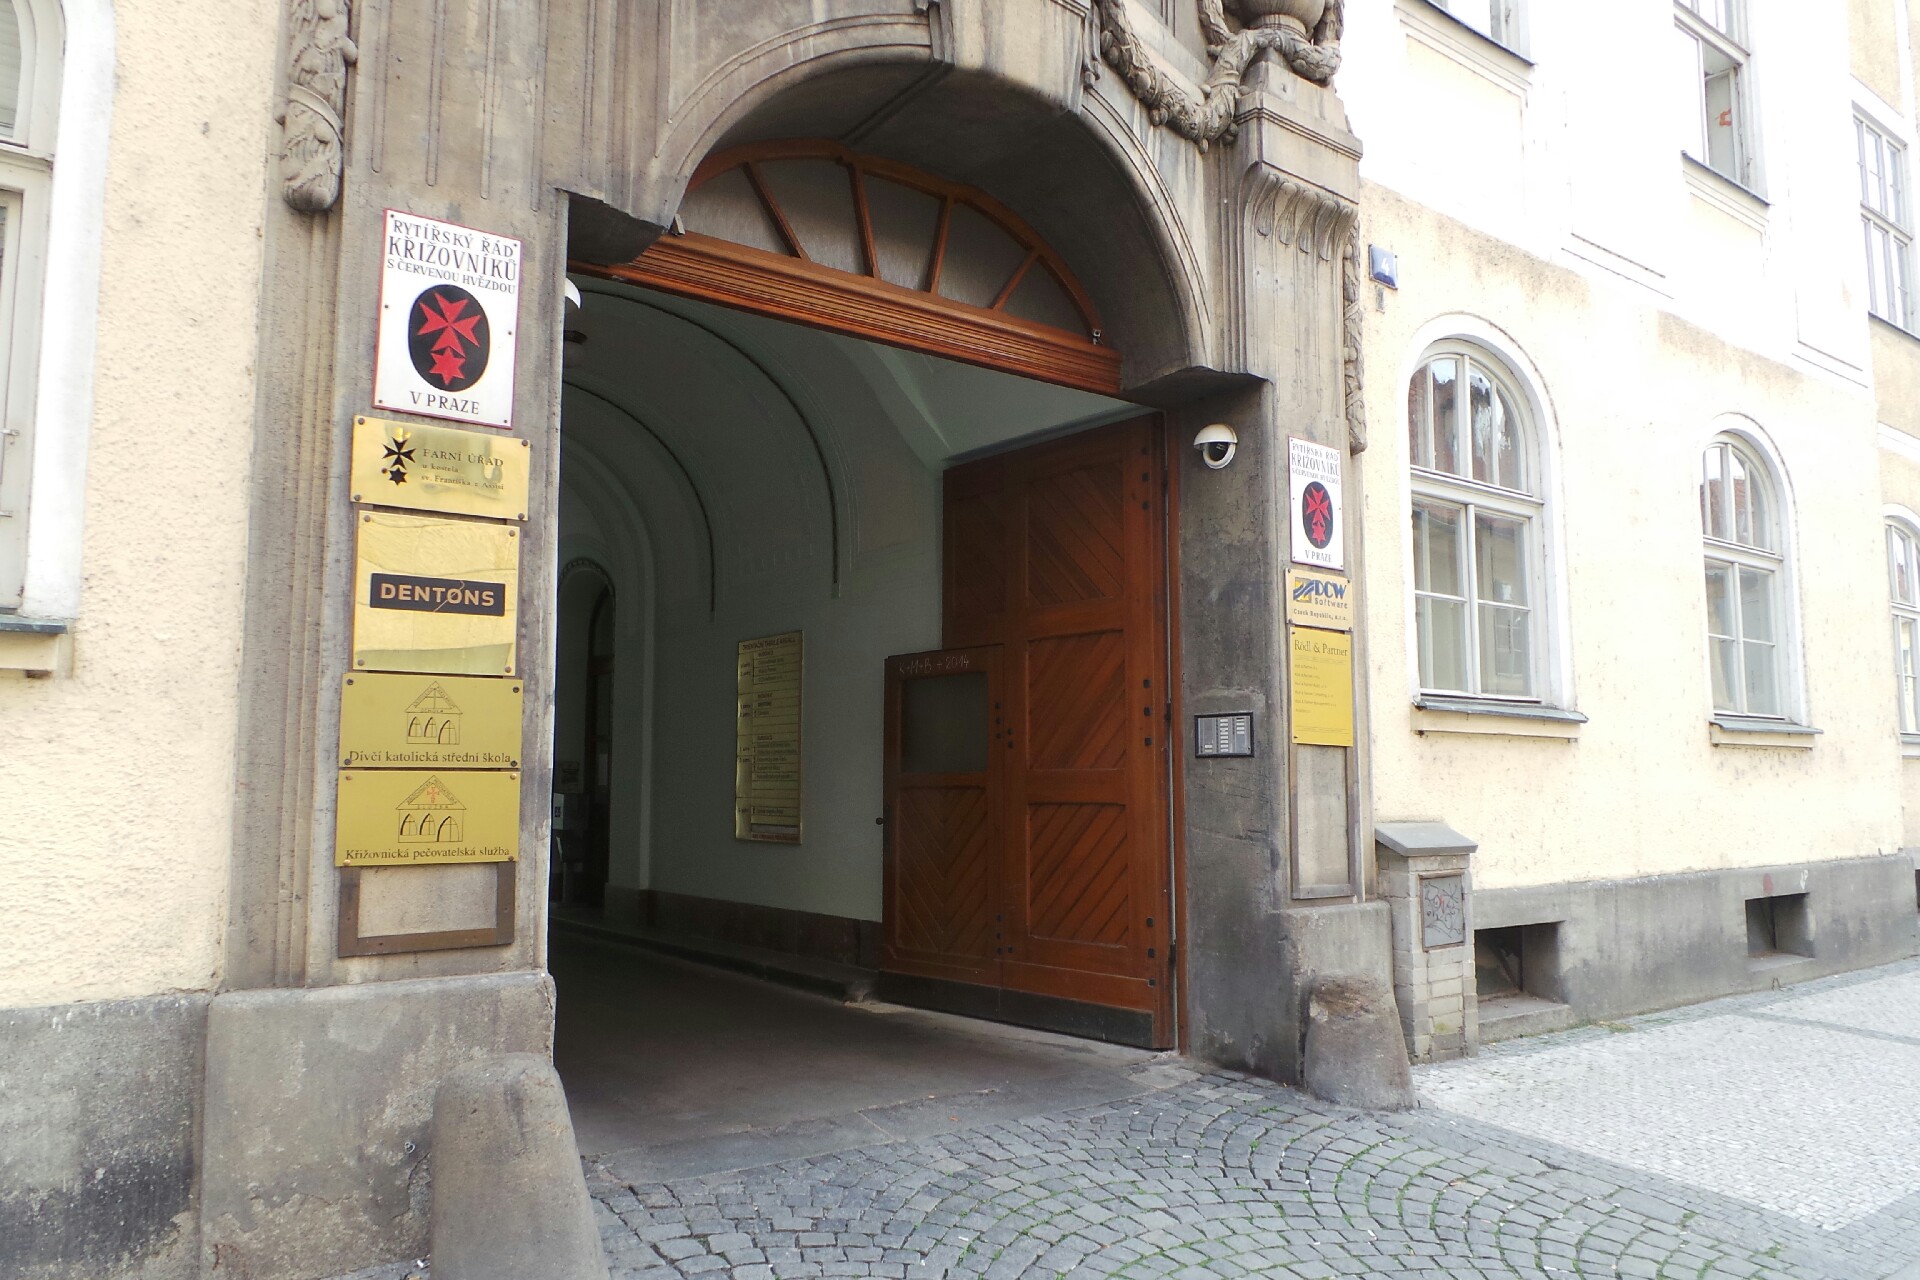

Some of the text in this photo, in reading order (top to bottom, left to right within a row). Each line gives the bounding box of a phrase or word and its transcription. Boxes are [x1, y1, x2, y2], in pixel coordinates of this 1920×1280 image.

[393, 219, 513, 257] RYTÍŘSKÝ ŘÁD
[389, 236, 517, 281] KŘIŽOVNÍKŮ
[1381, 258, 1390, 276] 4
[387, 258, 516, 294] S ČERVENOU HVĚZDOU
[410, 391, 480, 415] V PRAZE
[423, 448, 504, 467] FARNÍ ÚŘAD
[1305, 549, 1332, 563] V PRAZE
[380, 583, 495, 607] DENTONS
[1314, 579, 1347, 600] DCW
[1314, 597, 1348, 609] Software
[1294, 639, 1348, 657] Rödl & Partner
[349, 750, 511, 763] Dívčí katolická střední škola
[413, 848, 476, 861] pečovatelská
[479, 847, 510, 857] služba
